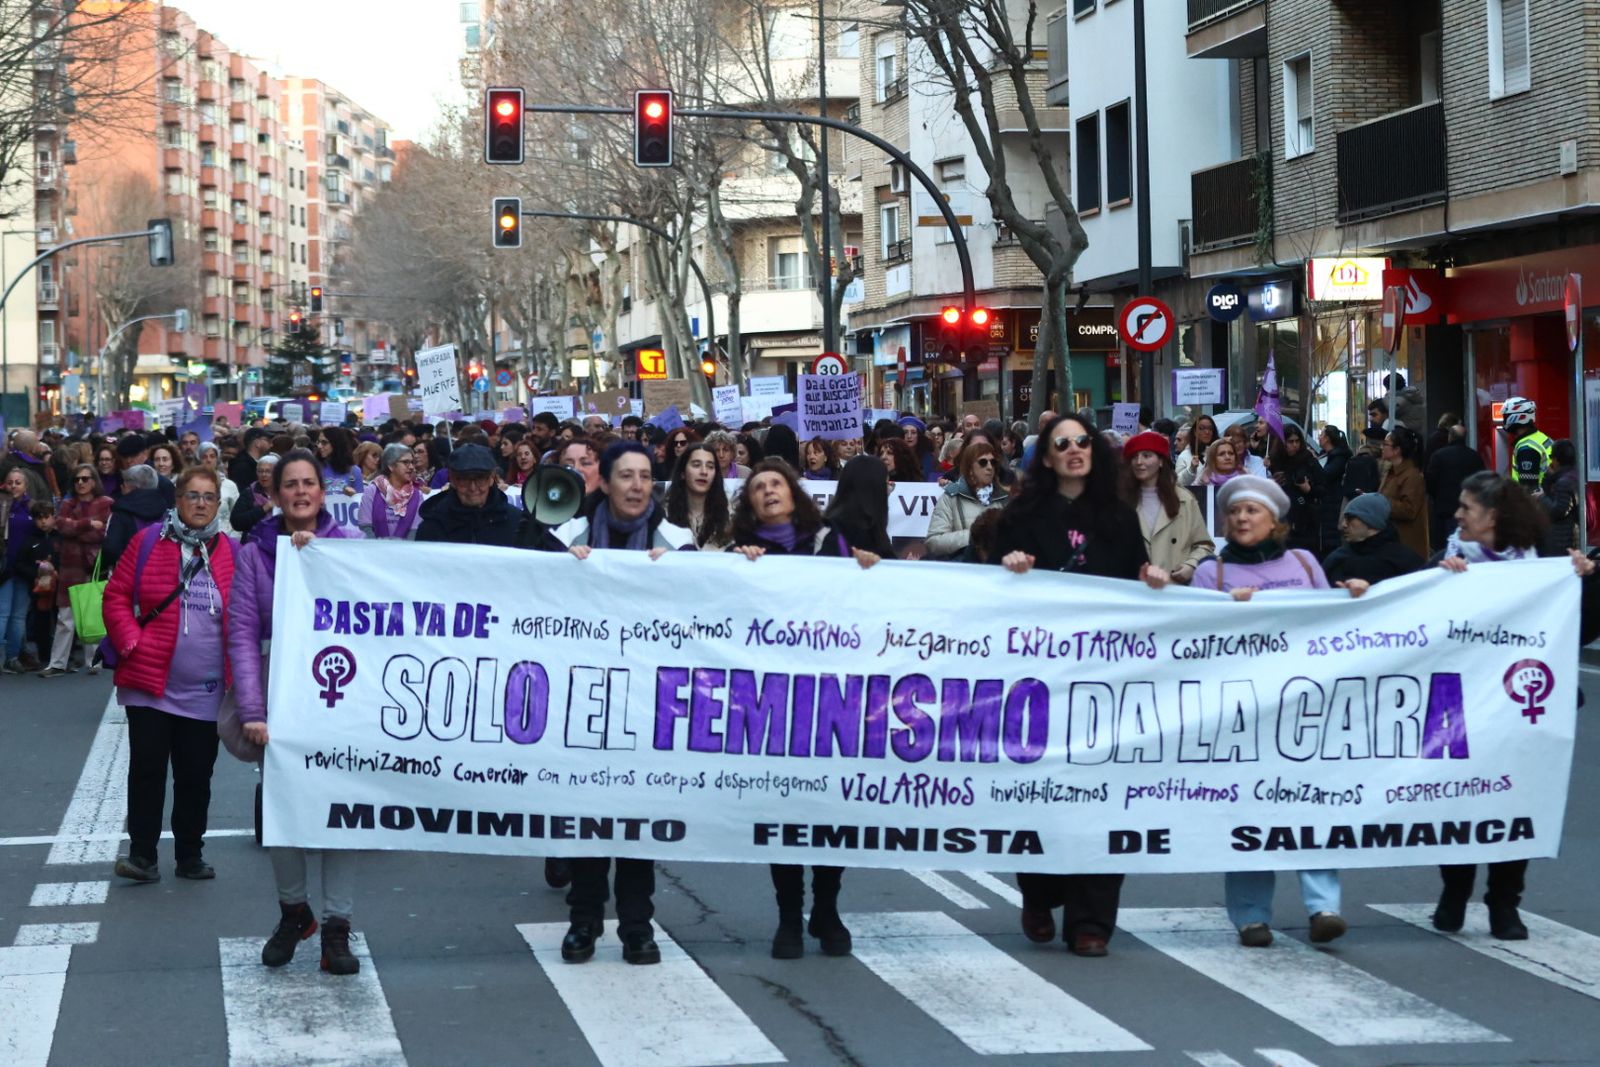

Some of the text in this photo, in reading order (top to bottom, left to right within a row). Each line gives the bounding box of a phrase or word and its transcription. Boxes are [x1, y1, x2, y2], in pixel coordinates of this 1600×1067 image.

[1212, 294, 1239, 307] DIGI
[1528, 268, 1569, 304] Santand
[423, 377, 456, 397] MUERTE
[432, 368, 444, 378] DE
[820, 364, 839, 376] 30
[313, 598, 404, 637] BASTA
[413, 601, 446, 637] YA
[620, 615, 733, 656] perseguirnos
[876, 622, 992, 660] juzgarnos
[1307, 624, 1429, 657] asesinarnos
[380, 654, 1470, 765] SOLO EL FEMINISMO DA LA CARA
[568, 766, 636, 787] nuestros
[646, 770, 706, 793] cuerpos
[714, 769, 829, 801] desprotegernos
[1124, 776, 1240, 811] prostituirnos
[326, 802, 1536, 855] MOVIMIENTO FEMINISTA DE SALAMANCA
